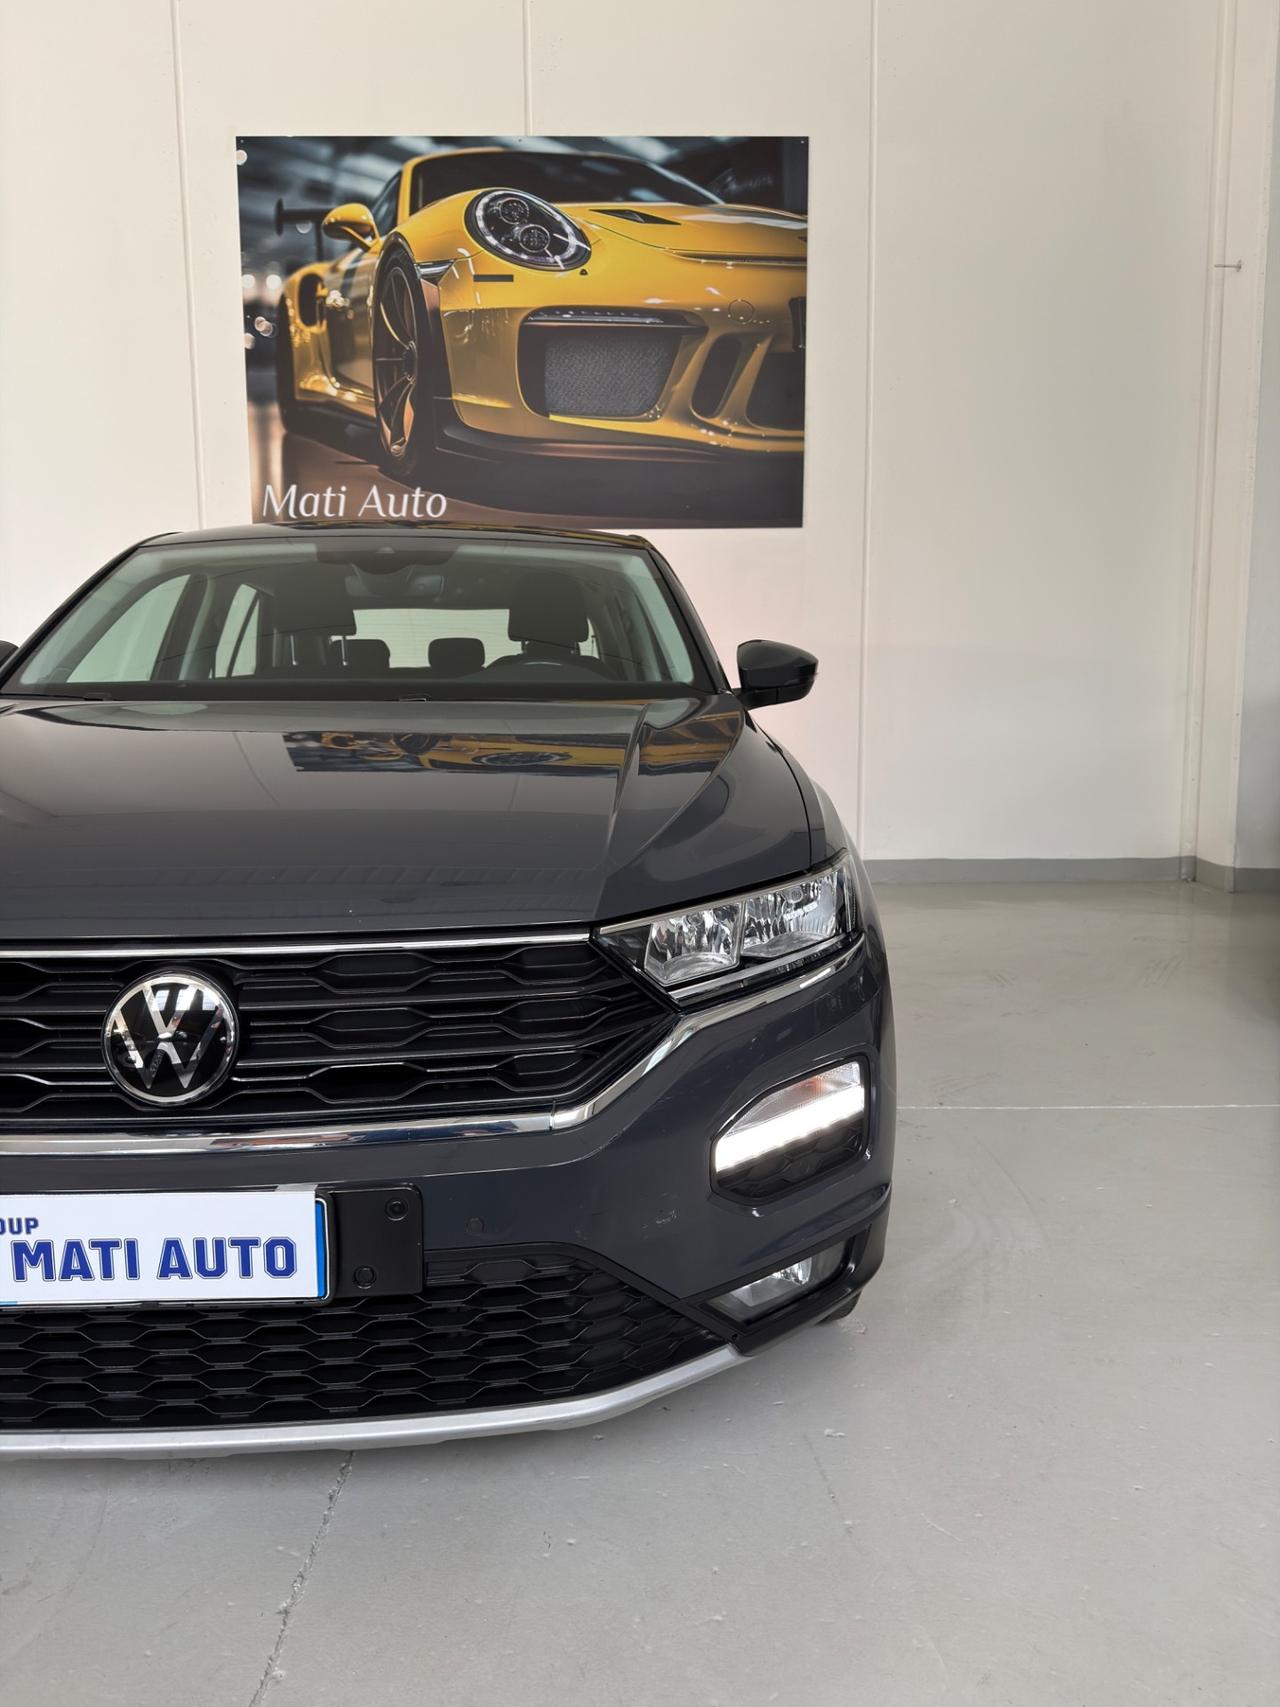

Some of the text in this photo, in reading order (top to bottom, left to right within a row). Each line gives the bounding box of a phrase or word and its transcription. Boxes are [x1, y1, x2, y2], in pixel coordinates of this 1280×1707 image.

[262, 484, 447, 519] Mati Auto
[10, 1236, 297, 1282] MATI AUTO
